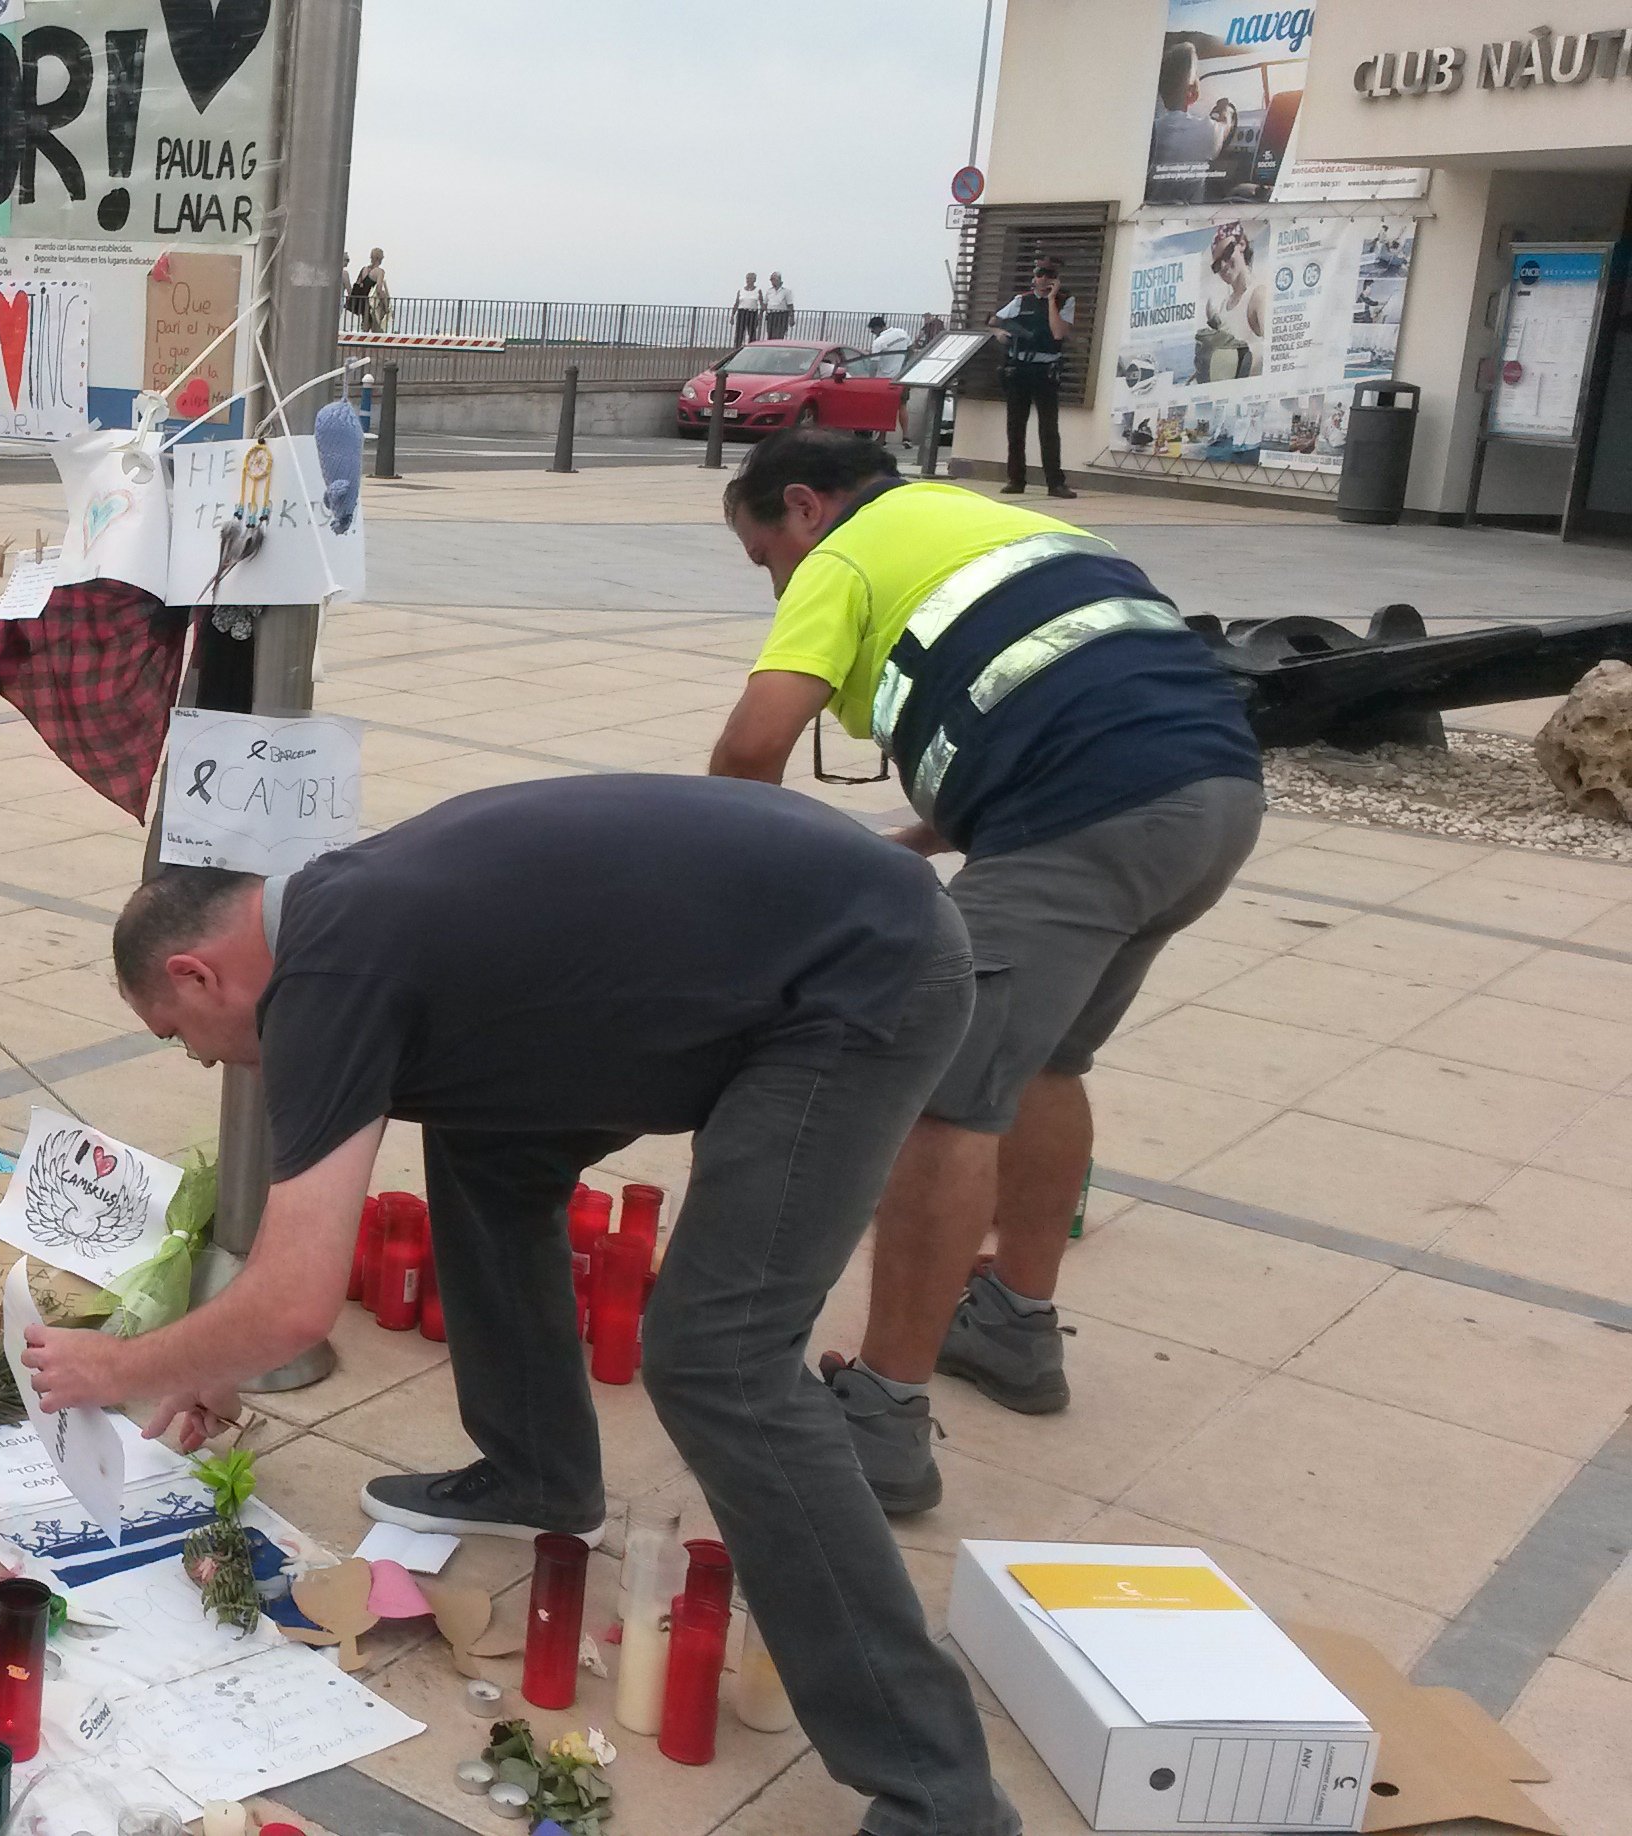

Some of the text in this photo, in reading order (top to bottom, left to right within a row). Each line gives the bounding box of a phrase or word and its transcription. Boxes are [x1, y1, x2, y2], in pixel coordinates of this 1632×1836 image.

[1353, 45, 1466, 97] CLUB
[155, 136, 257, 181] PAULA G
[172, 282, 212, 315] Que
[1129, 309, 1149, 329] CON
[1271, 321, 1311, 335] VELA LIGERA
[1272, 314, 1304, 325] CRUCERO
[1270, 339, 1313, 352] PADDLE SURF
[1271, 332, 1305, 343] WINDSURF
[269, 745, 317, 763] BARCELONA
[61, 1169, 118, 1209] CAMBRILS
[1301, 1747, 1314, 1769] ANY
